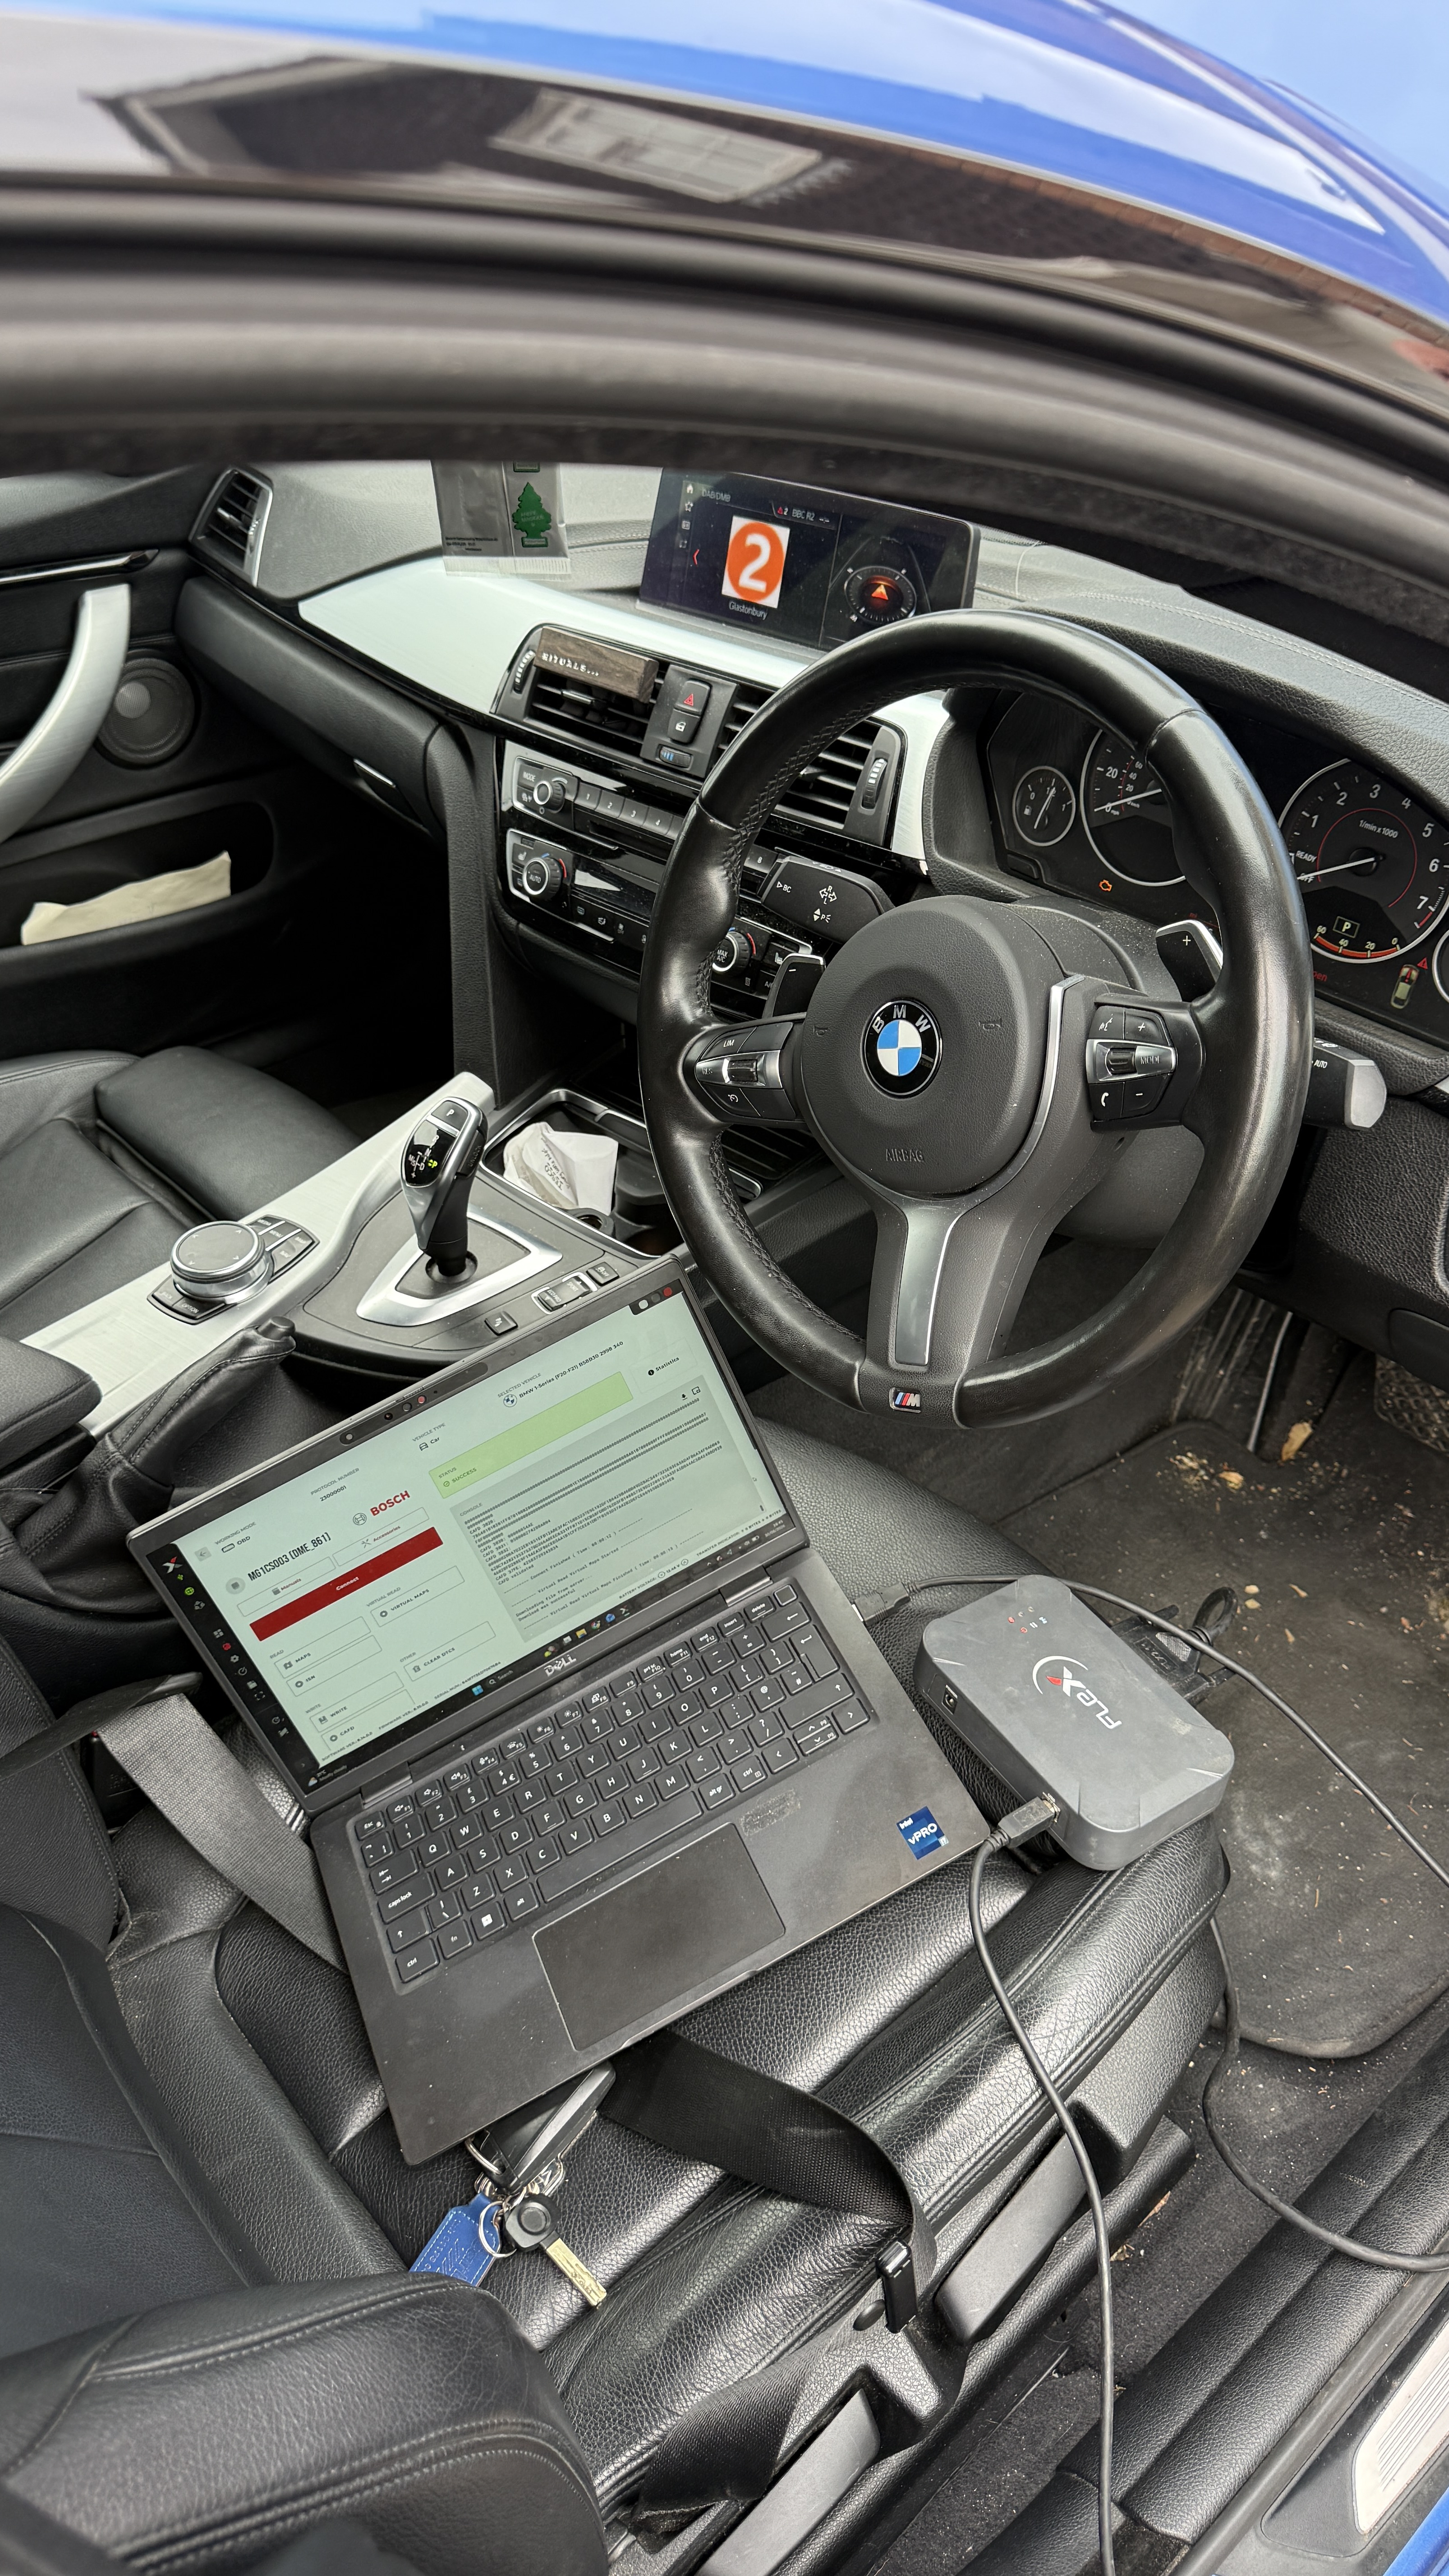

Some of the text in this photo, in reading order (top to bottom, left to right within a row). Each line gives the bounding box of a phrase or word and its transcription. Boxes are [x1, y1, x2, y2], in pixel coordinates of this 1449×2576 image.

[792, 508, 805, 519] BBC
[806, 512, 815, 521] R2
[738, 533, 771, 592] 2
[729, 601, 768, 620] Glastonbury
[1135, 761, 1143, 769] 60
[523, 771, 536, 782] MODE
[1106, 767, 1118, 779] 20
[1126, 784, 1134, 792] 20
[1370, 784, 1381, 798] 3
[1336, 792, 1347, 805] 2
[1402, 798, 1411, 809] 4
[1311, 815, 1318, 828] 1
[1359, 820, 1376, 832] 1/min
[1381, 827, 1398, 838] 1000
[1422, 823, 1435, 837] 5
[1296, 851, 1317, 863] READY
[1429, 859, 1440, 872] 6
[529, 874, 541, 883] AUTO
[783, 885, 791, 893] BC
[1417, 896, 1429, 909] 7
[1317, 925, 1327, 934] 60
[1342, 922, 1351, 932] P
[1339, 938, 1349, 947] 40
[1365, 941, 1375, 950] 20
[717, 949, 728, 958] MAX
[872, 1005, 931, 1033] BMW
[1140, 1055, 1162, 1065] MODE
[1314, 1060, 1328, 1068] AUTO
[885, 1148, 925, 1163] AIRBAG
[567, 1282, 579, 1292] SPORT
[547, 1289, 556, 1297] ECO
[182, 1303, 199, 1314] OPTION
[655, 1357, 680, 1371] Statistics
[497, 1373, 541, 1398] SELECTED VEHICLE
[519, 1388, 534, 1398] BMW
[906, 1394, 920, 1407] M
[412, 1423, 446, 1442] VEHICLE TYPE
[429, 1435, 441, 1444] Car
[438, 1467, 457, 1479] STATUS
[451, 1467, 477, 1483] SUCCESS
[310, 1468, 359, 1495] PROTOCOL NUMBER
[320, 1485, 347, 1501] 23000001
[370, 1490, 410, 1516] BOSCH
[460, 1503, 483, 1516] CONSOLE
[215, 1522, 256, 1545] WORKING MODE
[373, 1526, 401, 1542] Accessories
[237, 1536, 250, 1545] OBD
[696, 1544, 717, 1556] TRANSFER
[248, 1554, 290, 1581] MG1CS003
[511, 1564, 534, 1578] validated
[530, 1556, 571, 1580] Connect Finished
[538, 1547, 619, 1593] Virtual Virtual Started
[281, 1578, 302, 1591] Manuals
[336, 1577, 359, 1591] Connect
[366, 1587, 401, 1607] VIRTUAL READ
[550, 1569, 633, 1615] Virtual Virtual Finished
[391, 1589, 429, 1611] VIRTUAL MAPS
[518, 1608, 539, 1622] Download
[550, 1588, 575, 1604] successful
[515, 1600, 544, 1617] Downloading
[751, 1603, 765, 1613] delete
[723, 1618, 737, 1628] insert
[699, 1634, 708, 1642] end
[270, 1649, 284, 1659] READ
[295, 1653, 311, 1663] MAPS
[400, 1652, 416, 1662] OTHER
[423, 1647, 455, 1666] CLEAR DTCS
[544, 1654, 576, 1677] DELL
[497, 1670, 513, 1680] Search
[711, 1686, 718, 1695] P
[305, 1704, 321, 1714] WRITE
[330, 1706, 347, 1717] WRITE
[681, 1703, 689, 1712] O
[340, 1726, 354, 1736] CAFD
[619, 1737, 627, 1747] U
[669, 1741, 678, 1751] K
[322, 1747, 346, 1761] SOFTWARE
[588, 1755, 594, 1764] Y
[641, 1759, 646, 1768] J
[557, 1772, 563, 1781] T
[743, 1768, 753, 1777] ctrl
[607, 1777, 616, 1787] H
[666, 1776, 676, 1787] M
[470, 1796, 475, 1804] 3
[524, 1791, 533, 1800] R
[575, 1794, 584, 1804] G
[635, 1794, 644, 1805] N
[438, 1813, 444, 1822] 2
[493, 1808, 501, 1818] E
[543, 1812, 550, 1823] F
[603, 1813, 611, 1823] B
[899, 1817, 914, 1830] intel
[460, 1825, 469, 1836] W
[511, 1831, 519, 1841] D
[570, 1831, 577, 1840] V
[908, 1823, 938, 1845] vPRO
[428, 1844, 437, 1854] Q
[479, 1849, 487, 1859] S
[538, 1849, 546, 1859] C
[447, 1868, 455, 1877] A
[505, 1868, 514, 1879] X
[473, 1886, 481, 1897] Z
[388, 1891, 412, 1908] caps lock
[407, 1957, 417, 1967] ctrl
